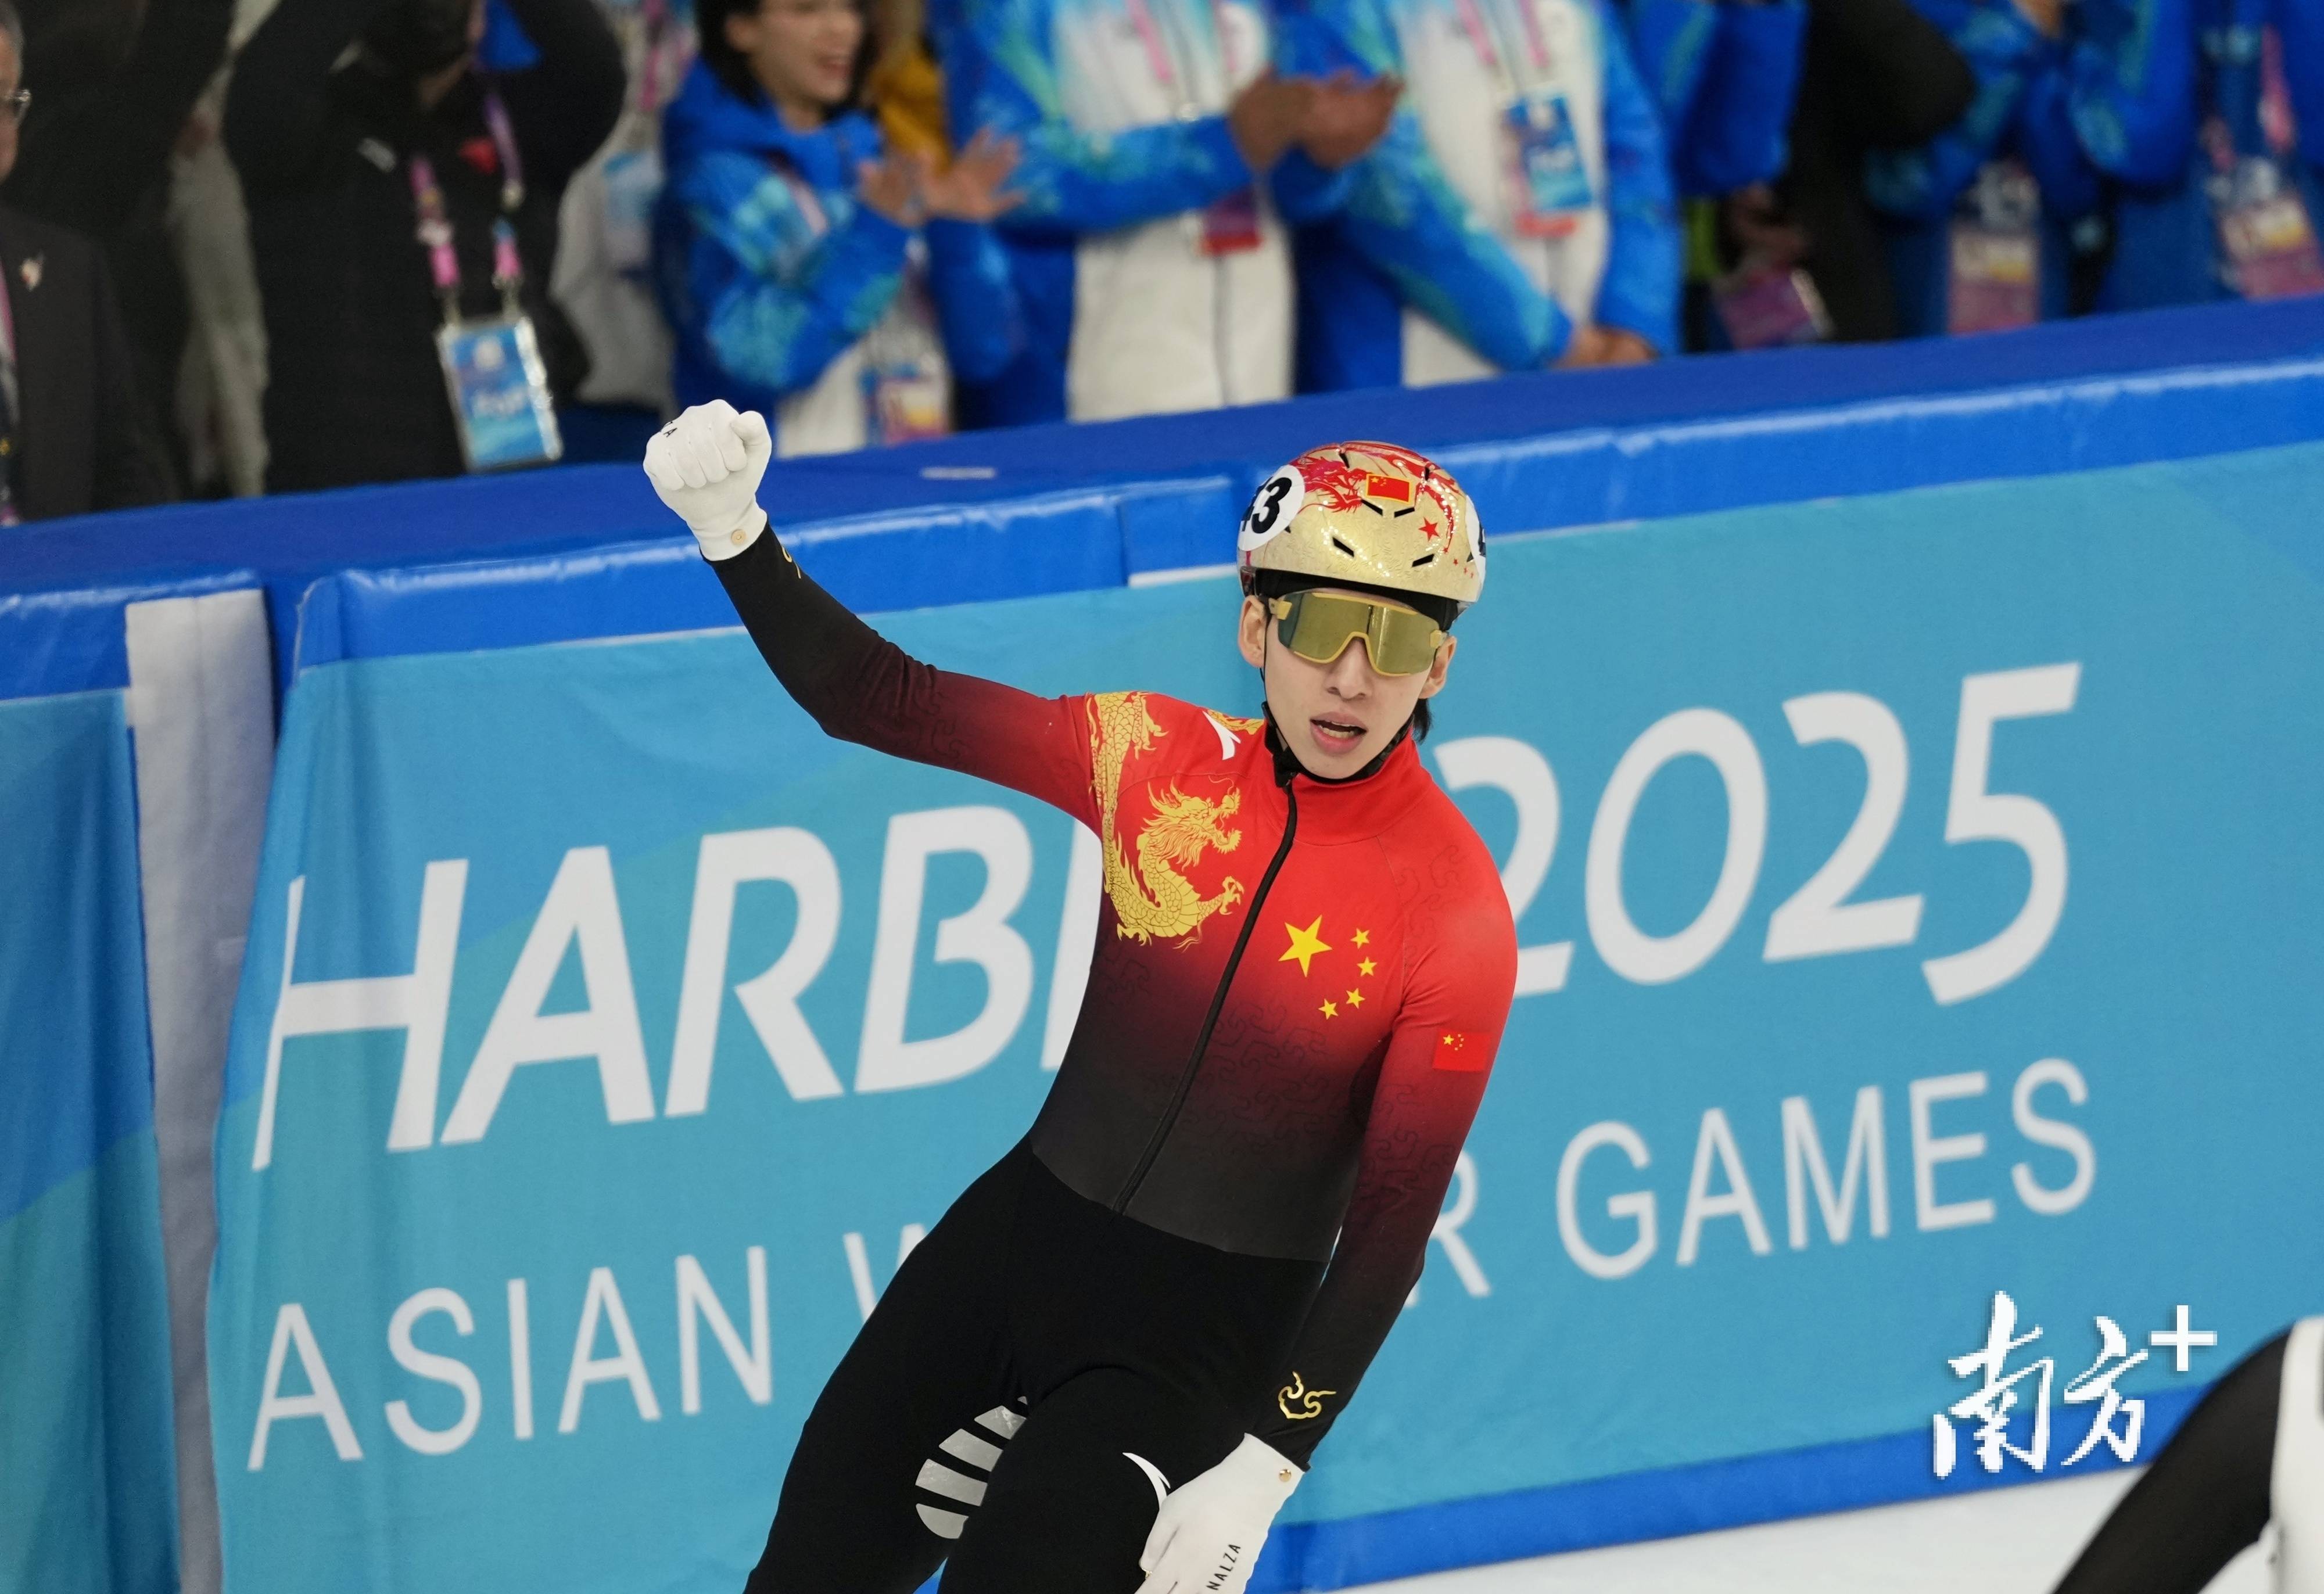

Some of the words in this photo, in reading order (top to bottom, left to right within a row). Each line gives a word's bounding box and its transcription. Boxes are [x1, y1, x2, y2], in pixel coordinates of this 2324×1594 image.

[1432, 662, 2082, 1006] 2025
[248, 1244, 773, 1471] ASIAN
[1555, 1058, 2096, 1279] GAMES
[1206, 1543, 1242, 1591] NALZA
